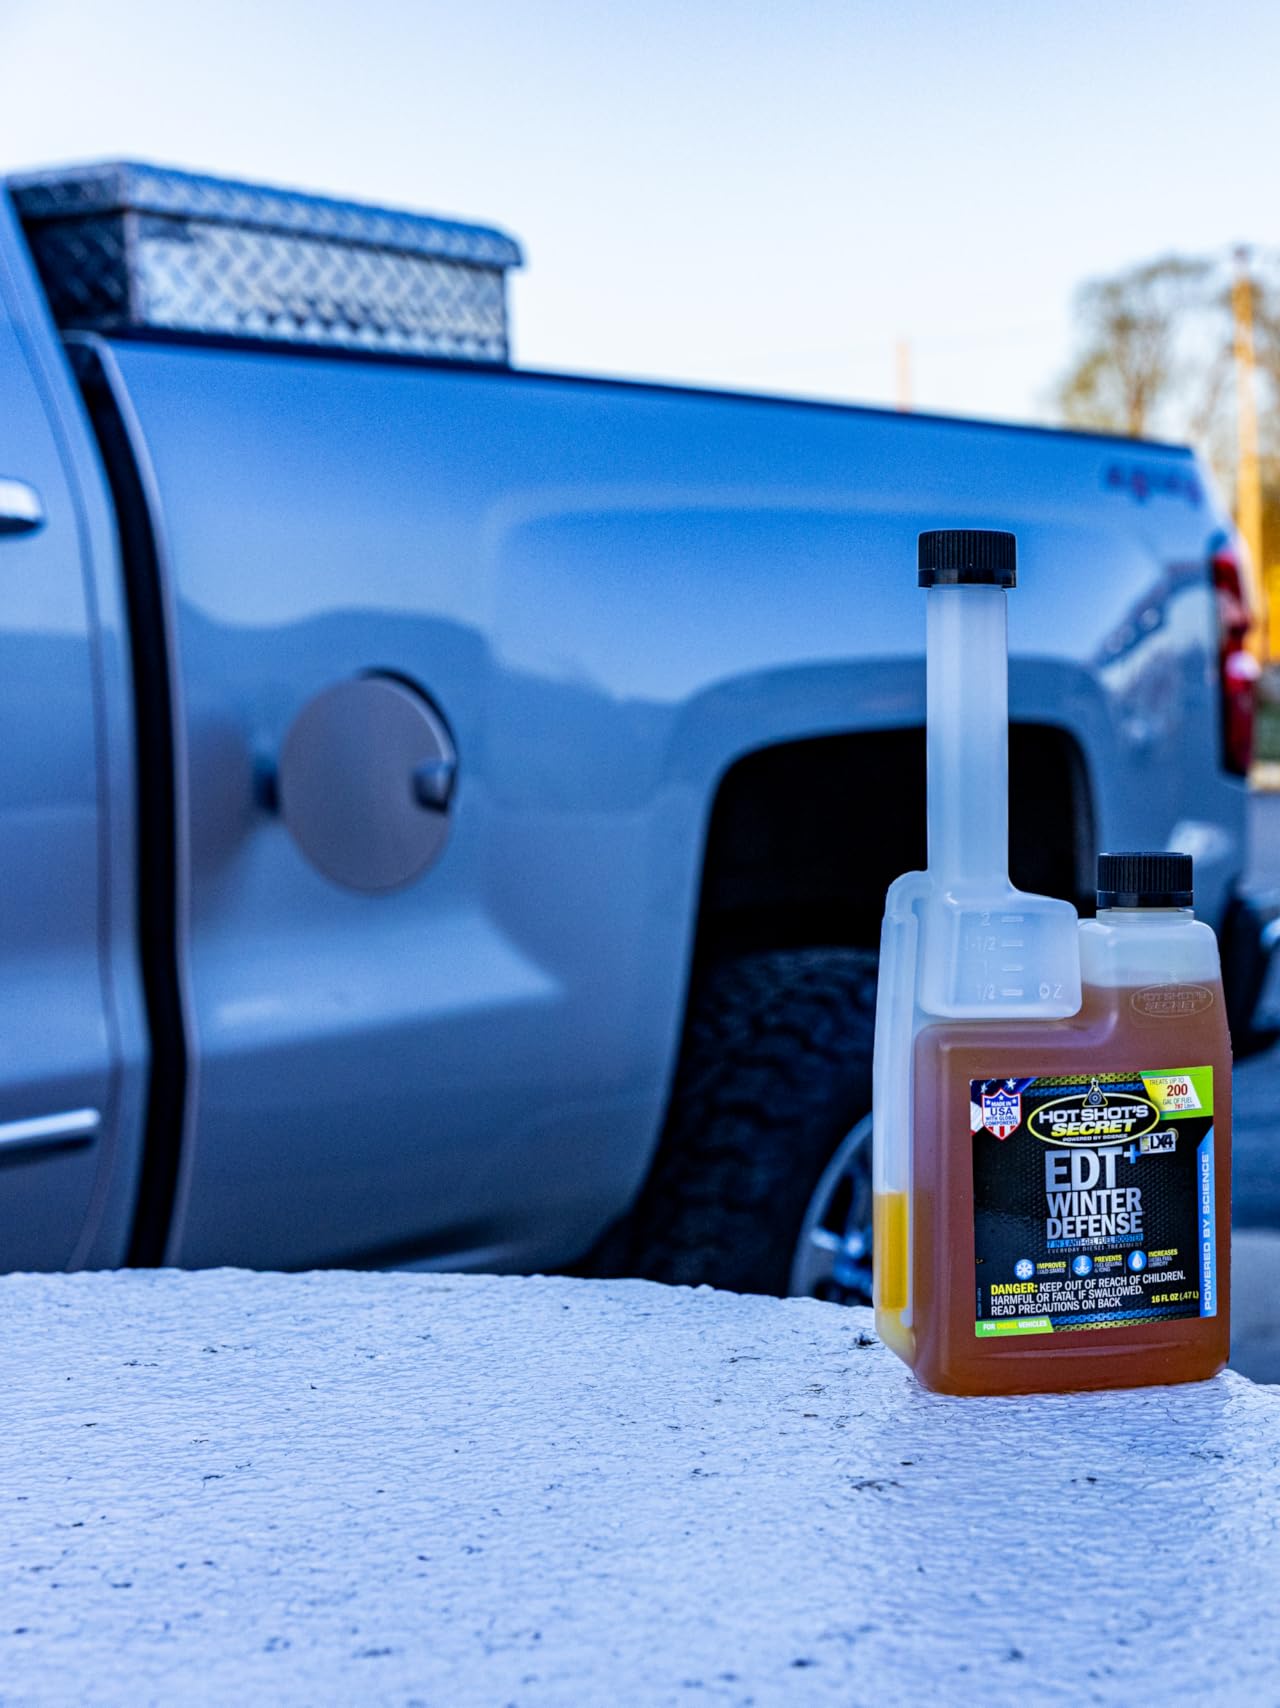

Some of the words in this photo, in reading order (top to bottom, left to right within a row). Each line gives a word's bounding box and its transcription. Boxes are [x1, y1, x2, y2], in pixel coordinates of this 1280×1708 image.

[1167, 1083, 1188, 1097] 200
[1180, 1096, 1193, 1104] FUEL
[991, 1107, 1013, 1116] USA
[1039, 1109, 1080, 1123] HOT
[1081, 1105, 1149, 1121] SHOT'S
[1051, 1118, 1137, 1137] SECRET
[1150, 1133, 1173, 1149] LX4
[1202, 1153, 1210, 1214] SCIENCE
[1046, 1187, 1143, 1218] WINTER
[1046, 1211, 1143, 1239] DEFENSE
[1203, 1218, 1210, 1238] BY
[1094, 1254, 1123, 1262] PREVENTS
[1148, 1249, 1178, 1257] INCREASES
[990, 1282, 1038, 1296] DANGER:
[1039, 1281, 1063, 1292] KEEP
[1064, 1279, 1083, 1291] OUT
[1084, 1278, 1097, 1289] OF
[1098, 1276, 1127, 1288] REACH
[1129, 1275, 1141, 1285] OF
[1142, 1270, 1186, 1284] CHILDREN.
[1203, 1242, 1212, 1310] POWERED
[990, 1294, 1035, 1306] HARMFUL
[1036, 1293, 1050, 1303] OR
[1051, 1291, 1076, 1302] FATAL
[1078, 1289, 1086, 1300] IF
[1088, 1285, 1144, 1299] SWALLOWED.
[1160, 1294, 1169, 1302] FL
[1169, 1292, 1179, 1301] OZ
[1179, 1291, 1192, 1301] (.47
[1192, 1290, 1199, 1299] L)
[990, 1305, 1016, 1316] READ
[1018, 1301, 1080, 1314] PRECAUTIONS
[1081, 1299, 1096, 1310] ON
